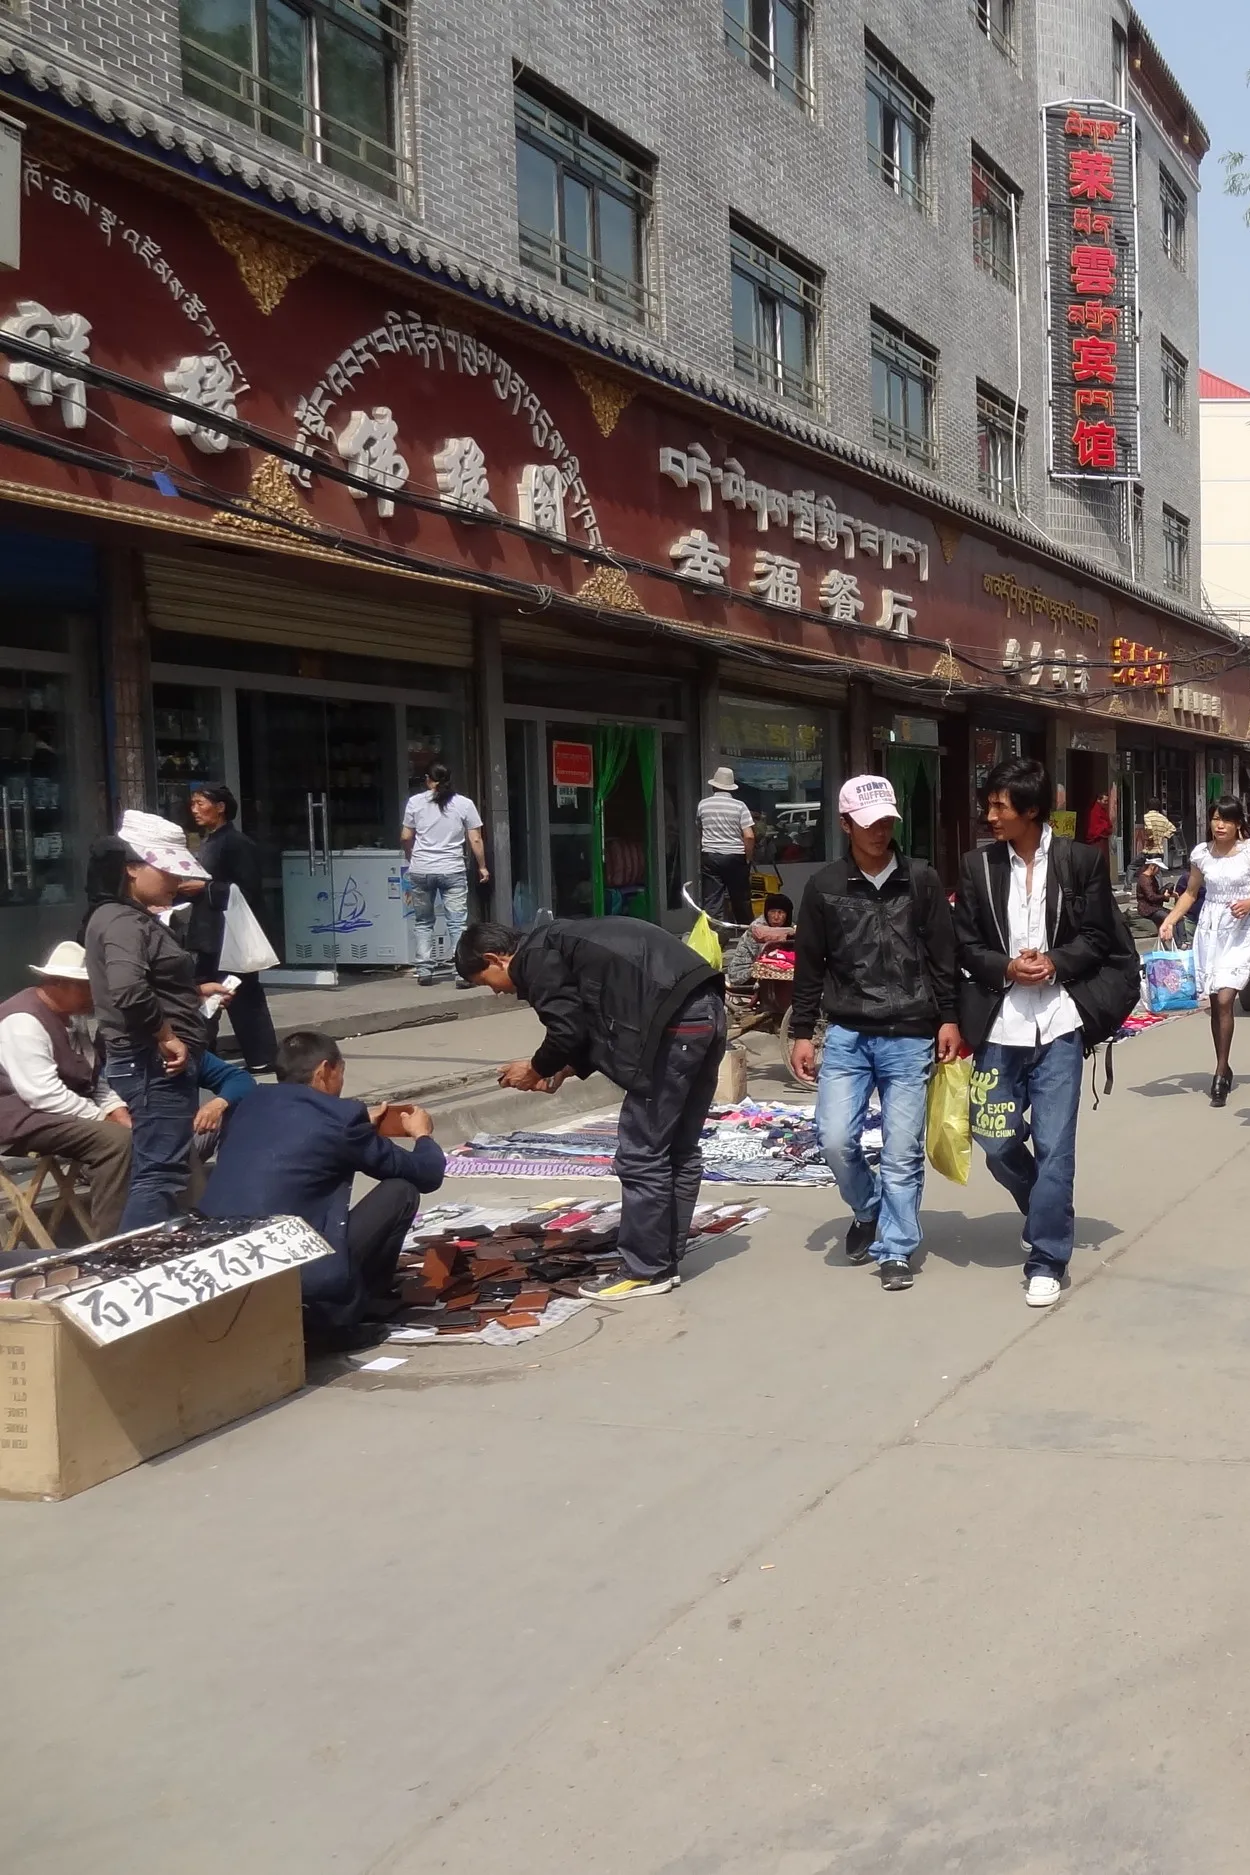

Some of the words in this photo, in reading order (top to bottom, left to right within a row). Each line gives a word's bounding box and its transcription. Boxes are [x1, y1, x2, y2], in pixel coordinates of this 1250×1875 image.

[669, 530, 917, 638] 幸福餐厅
[987, 1101, 1016, 1114] EXPO
[995, 1128, 1017, 1138] CHINA
